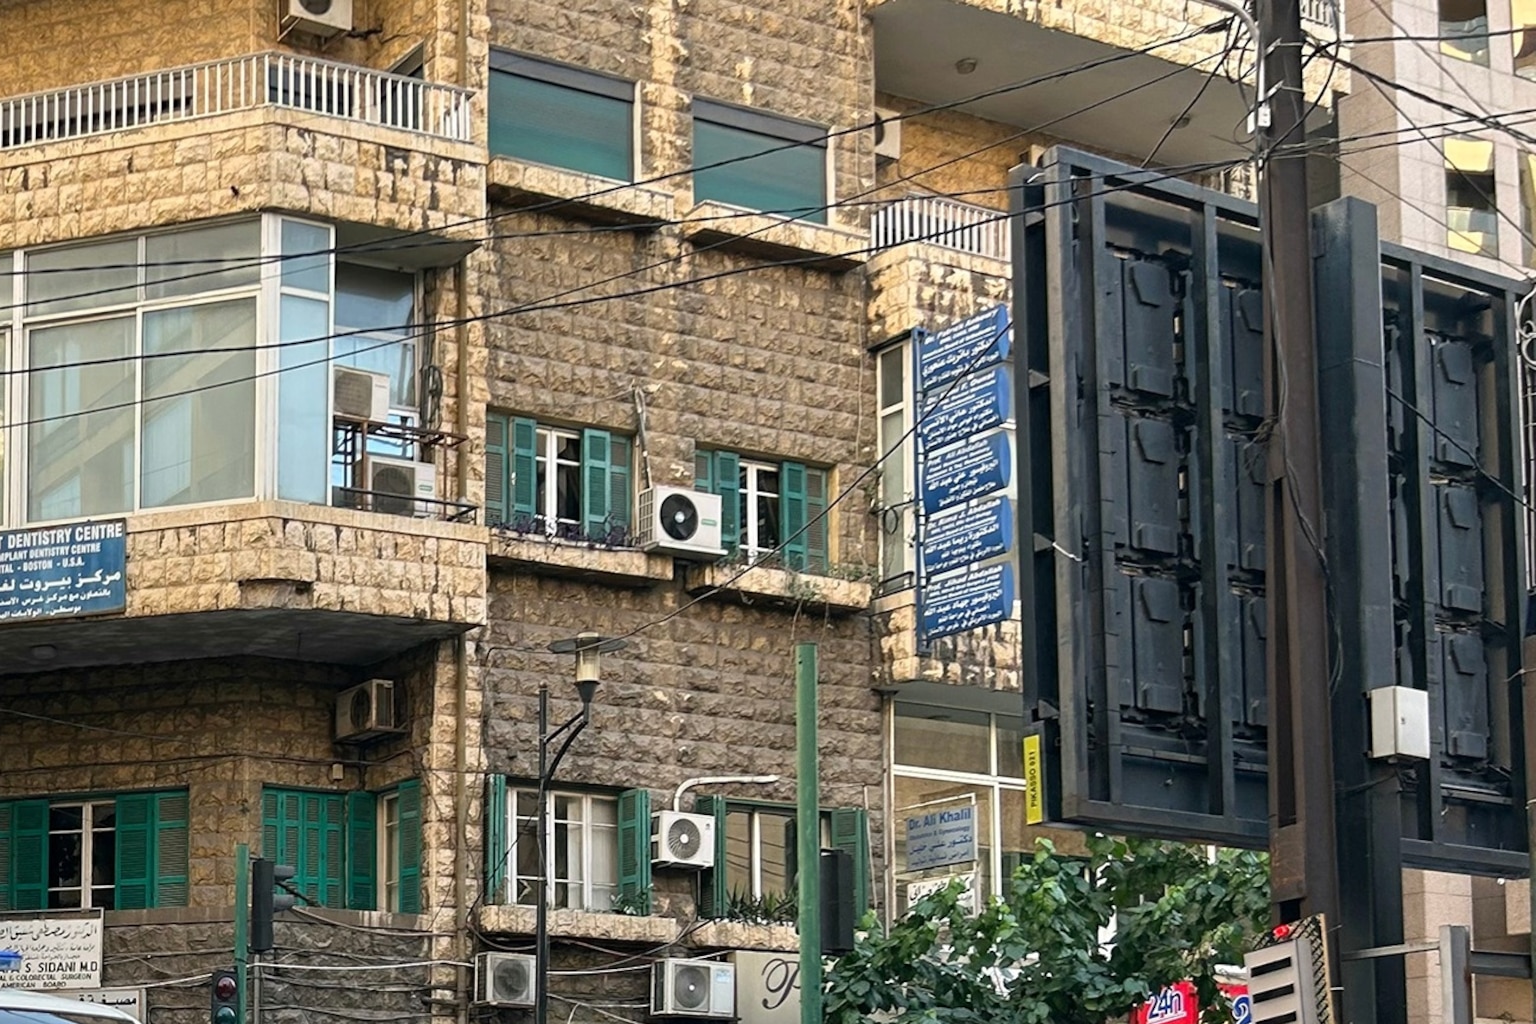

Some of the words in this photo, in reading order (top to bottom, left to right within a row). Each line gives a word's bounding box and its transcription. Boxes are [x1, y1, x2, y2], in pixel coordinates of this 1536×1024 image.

[8, 528, 72, 549] DENTISTRY
[75, 523, 123, 542] CENTRE
[29, 545, 70, 559] DENTISTRY
[71, 542, 101, 554] CENTRE
[23, 560, 53, 572] BOSTON
[19, 576, 72, 592] بيروت
[75, 568, 121, 588] مركز
[909, 819, 921, 830] Dr.
[923, 814, 936, 827] Ali
[939, 807, 971, 824] Khalil
[38, 961, 76, 973] SIDANI
